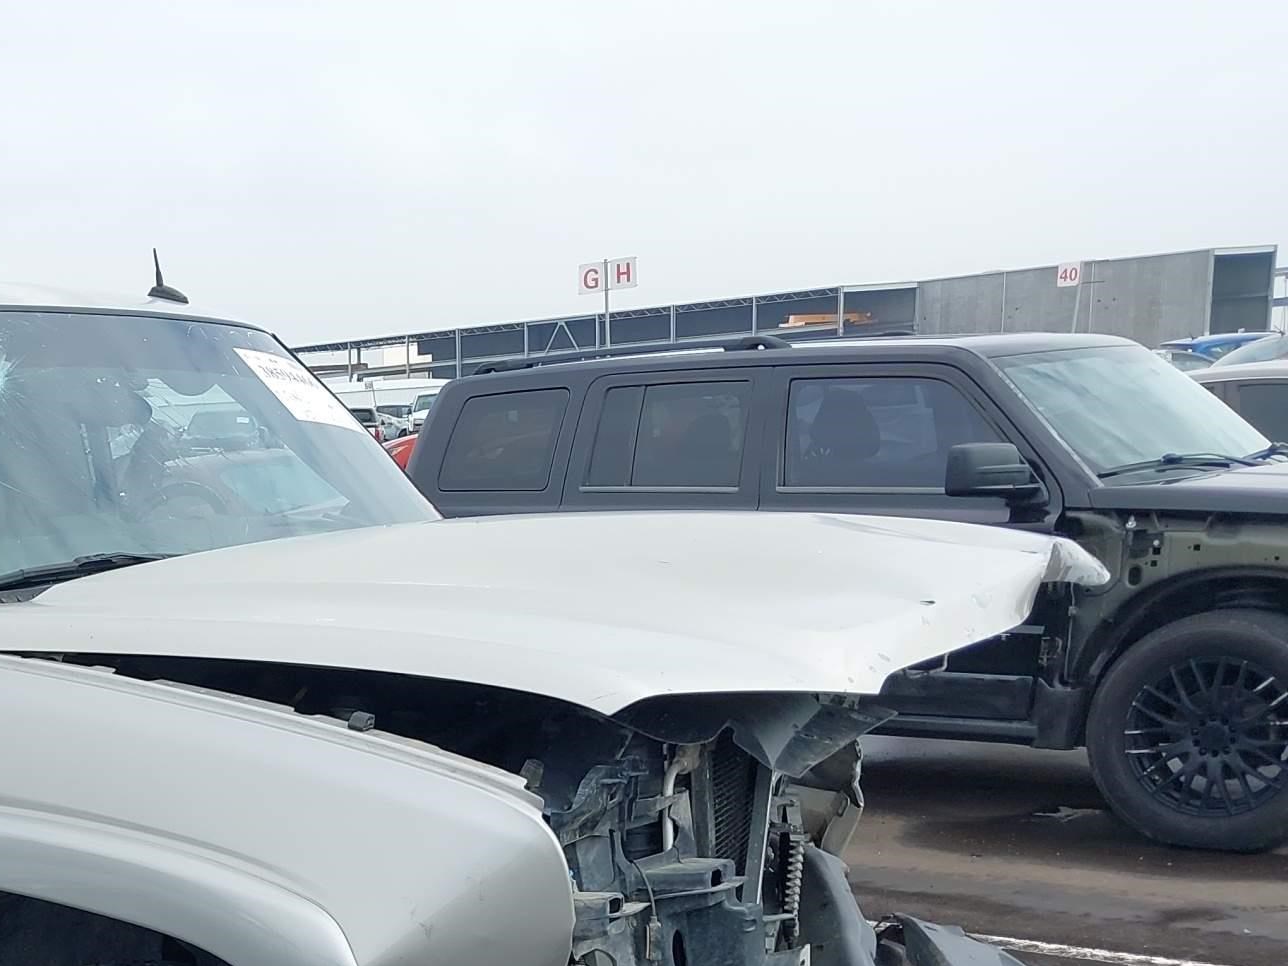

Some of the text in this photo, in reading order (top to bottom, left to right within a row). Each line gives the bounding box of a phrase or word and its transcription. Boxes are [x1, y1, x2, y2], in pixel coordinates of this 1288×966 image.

[583, 268, 598, 289] G
[616, 262, 630, 284] H
[1059, 267, 1078, 282] 40
